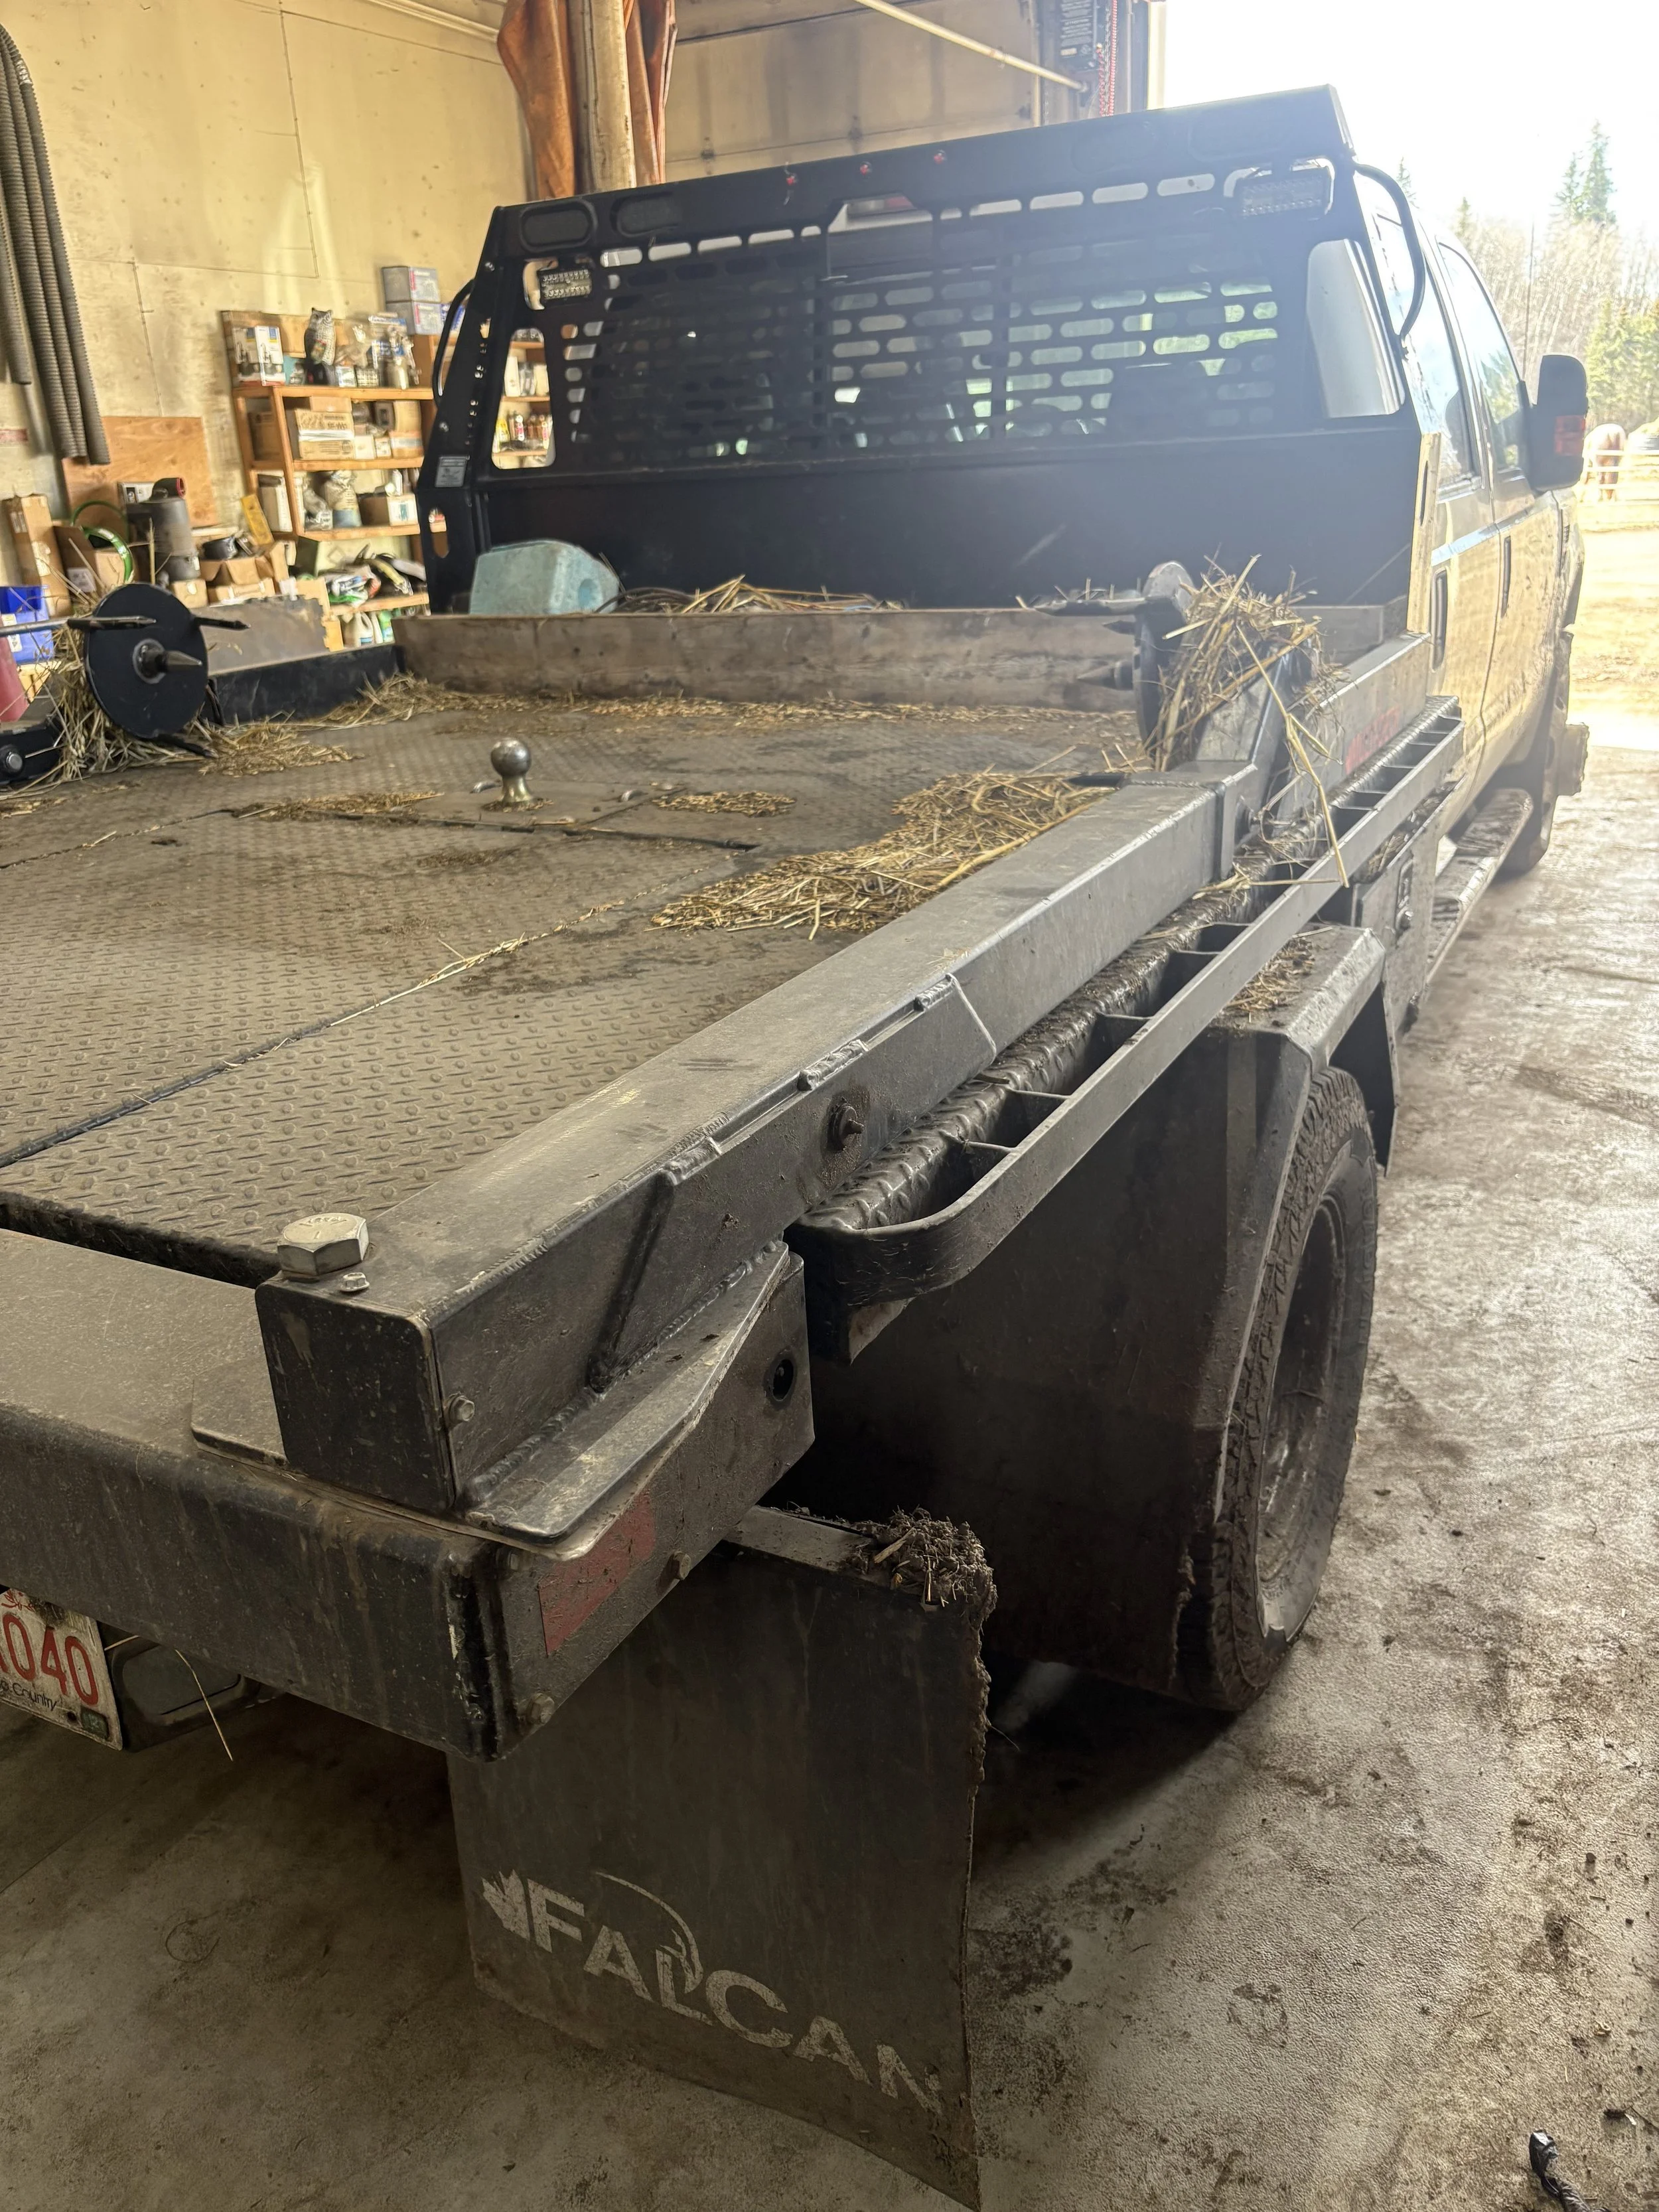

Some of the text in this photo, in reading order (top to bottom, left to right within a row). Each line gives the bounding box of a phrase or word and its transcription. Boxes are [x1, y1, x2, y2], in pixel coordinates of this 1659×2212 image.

[0, 1613, 98, 1706] 040
[12, 1682, 57, 1711] Country
[528, 1878, 943, 2120] FALCAN
